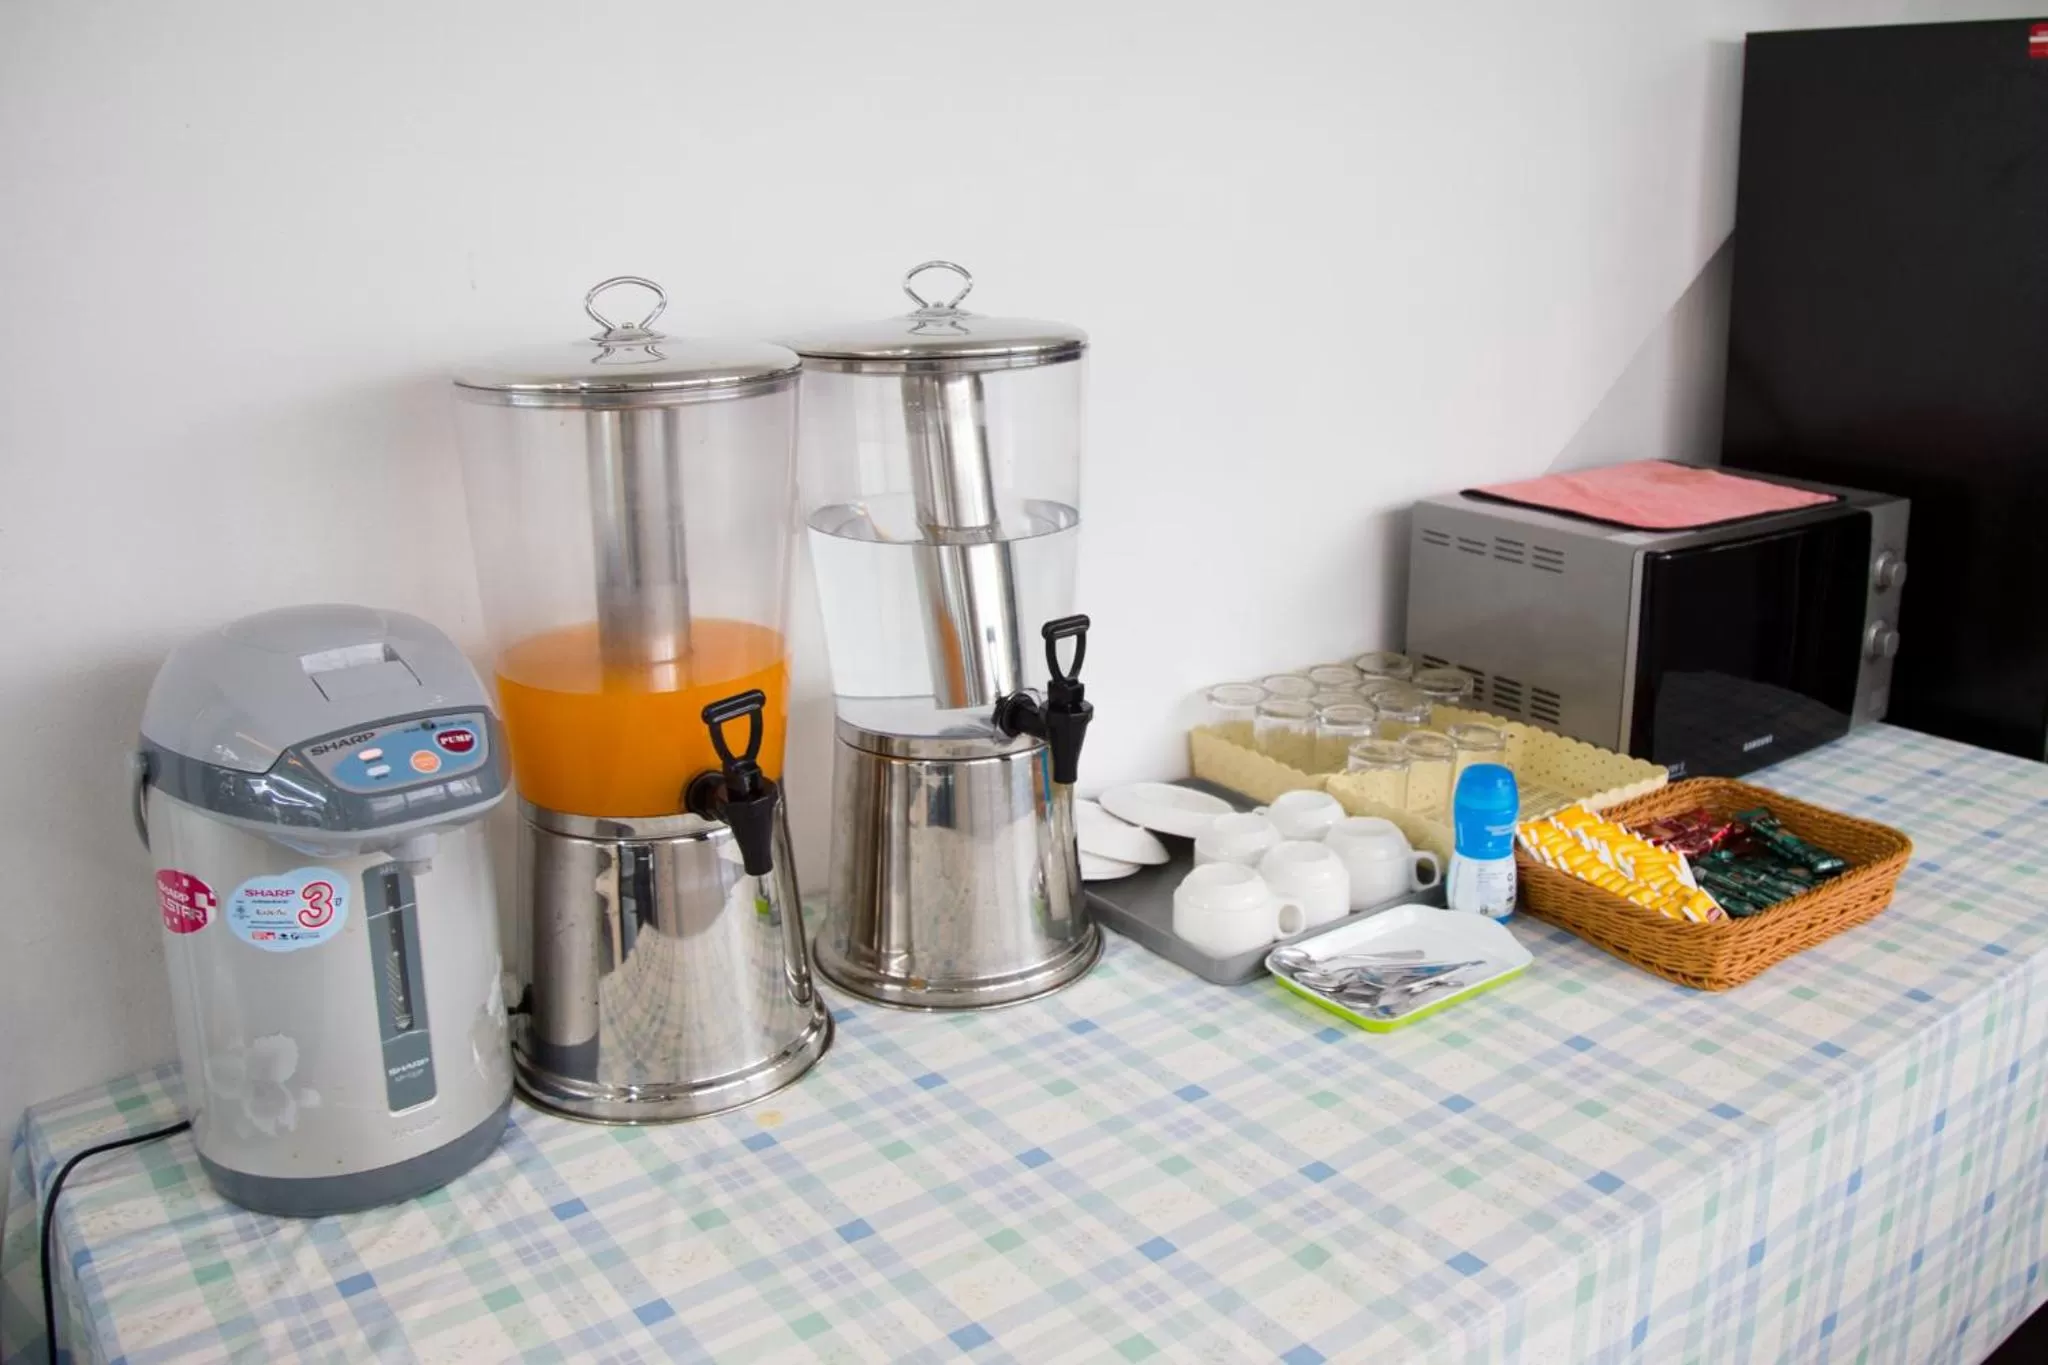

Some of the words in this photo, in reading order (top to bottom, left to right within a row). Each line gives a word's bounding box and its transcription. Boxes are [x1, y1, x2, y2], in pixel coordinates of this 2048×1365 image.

[310, 731, 376, 757] SHARP
[440, 733, 473, 746] PUMP
[244, 889, 296, 898] SHARP
[298, 881, 333, 928] 3
